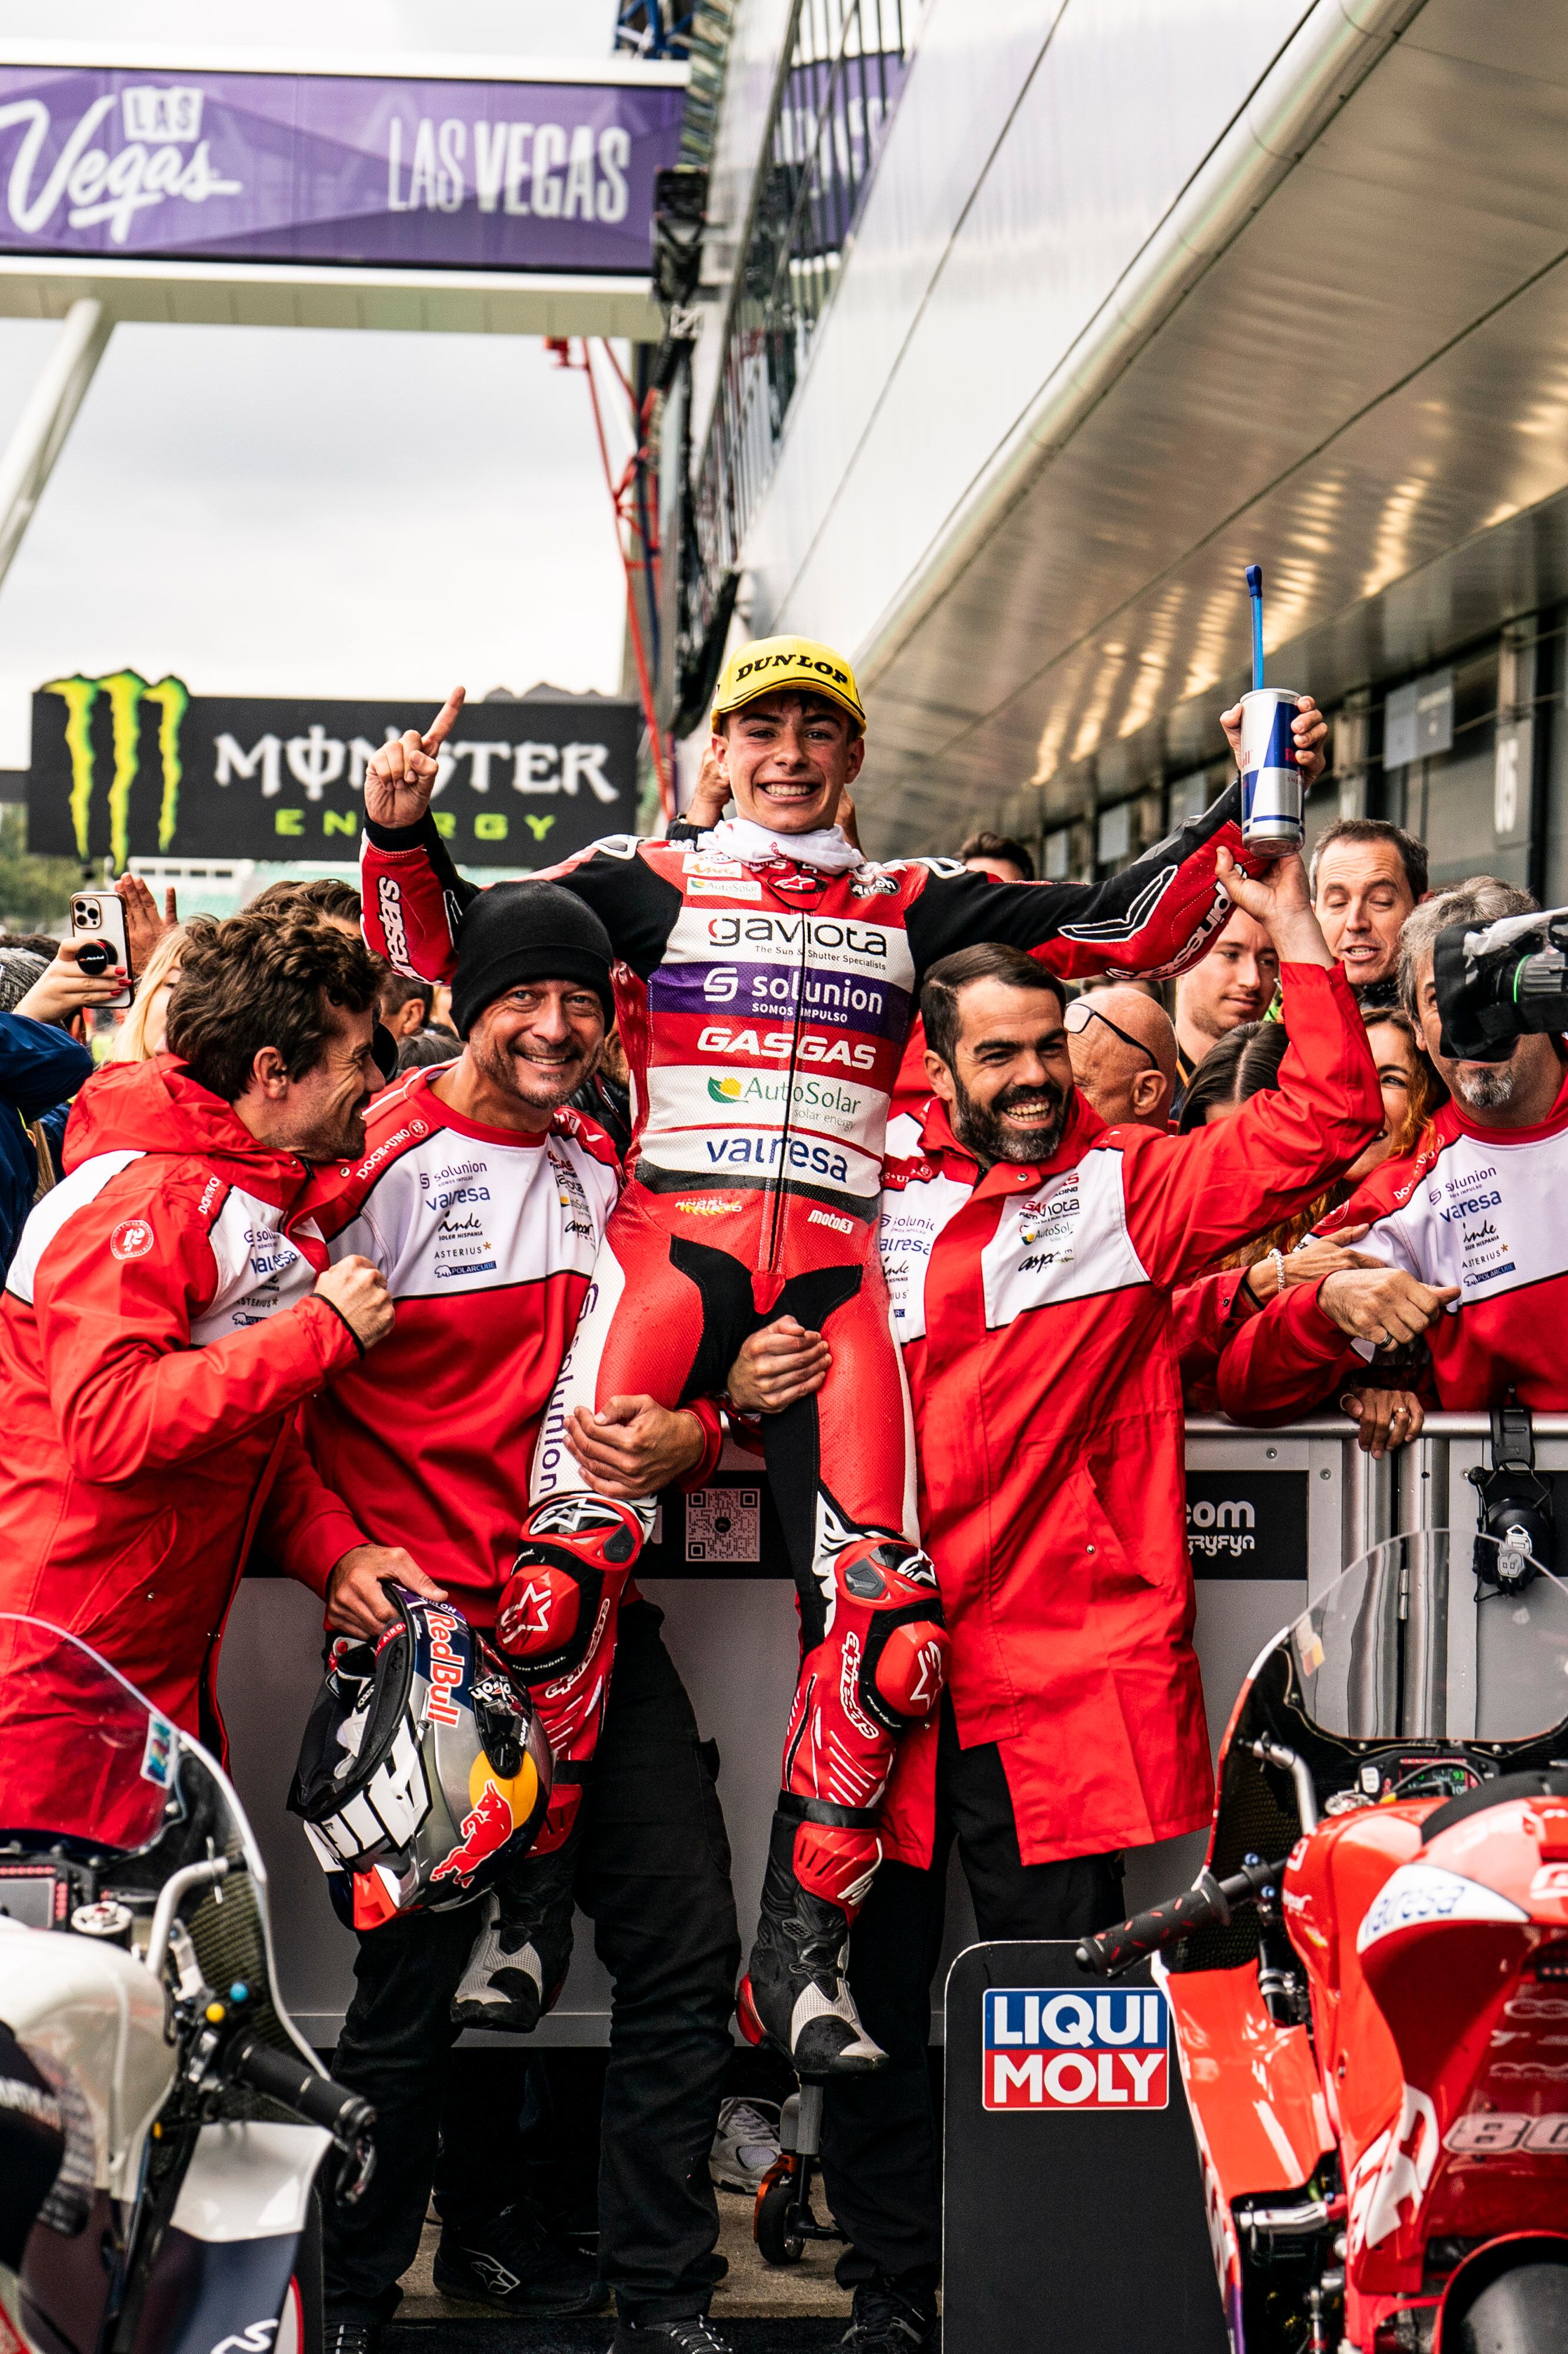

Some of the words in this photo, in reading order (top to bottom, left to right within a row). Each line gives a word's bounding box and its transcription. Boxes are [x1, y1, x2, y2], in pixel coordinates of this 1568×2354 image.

[124, 87, 202, 142] LAS
[0, 94, 242, 242] Vegas
[387, 117, 468, 213] LAS
[473, 120, 630, 223] VEGAS
[735, 654, 848, 684] DUNLOP
[275, 809, 555, 842] ENRGY
[708, 917, 887, 957] gaviota
[776, 947, 794, 956] Sun
[808, 949, 840, 962] Shutter
[843, 955, 886, 970] Specialists
[751, 971, 882, 1015] solunion
[751, 1002, 794, 1016] SOMOS
[800, 1007, 848, 1023] IMPULSO
[697, 1027, 877, 1070] GASGAS
[744, 1077, 861, 1114] AutoSolar
[794, 1108, 820, 1121] solar
[824, 1113, 854, 1132] energy
[434, 1160, 487, 1182] solunion
[1439, 1191, 1502, 1223] varesa
[458, 1231, 483, 1239] HISPANIA
[879, 1238, 931, 1256] alresa
[434, 1246, 482, 1259] ASTERIUS
[451, 1261, 495, 1274] POLARCUBE
[1462, 1250, 1501, 1269] ASTERIUS
[1477, 1265, 1513, 1282] POLARCUBE
[1186, 1500, 1255, 1528] om
[993, 1994, 1159, 2048] LIQUI
[993, 2053, 1164, 2104] MOLY
